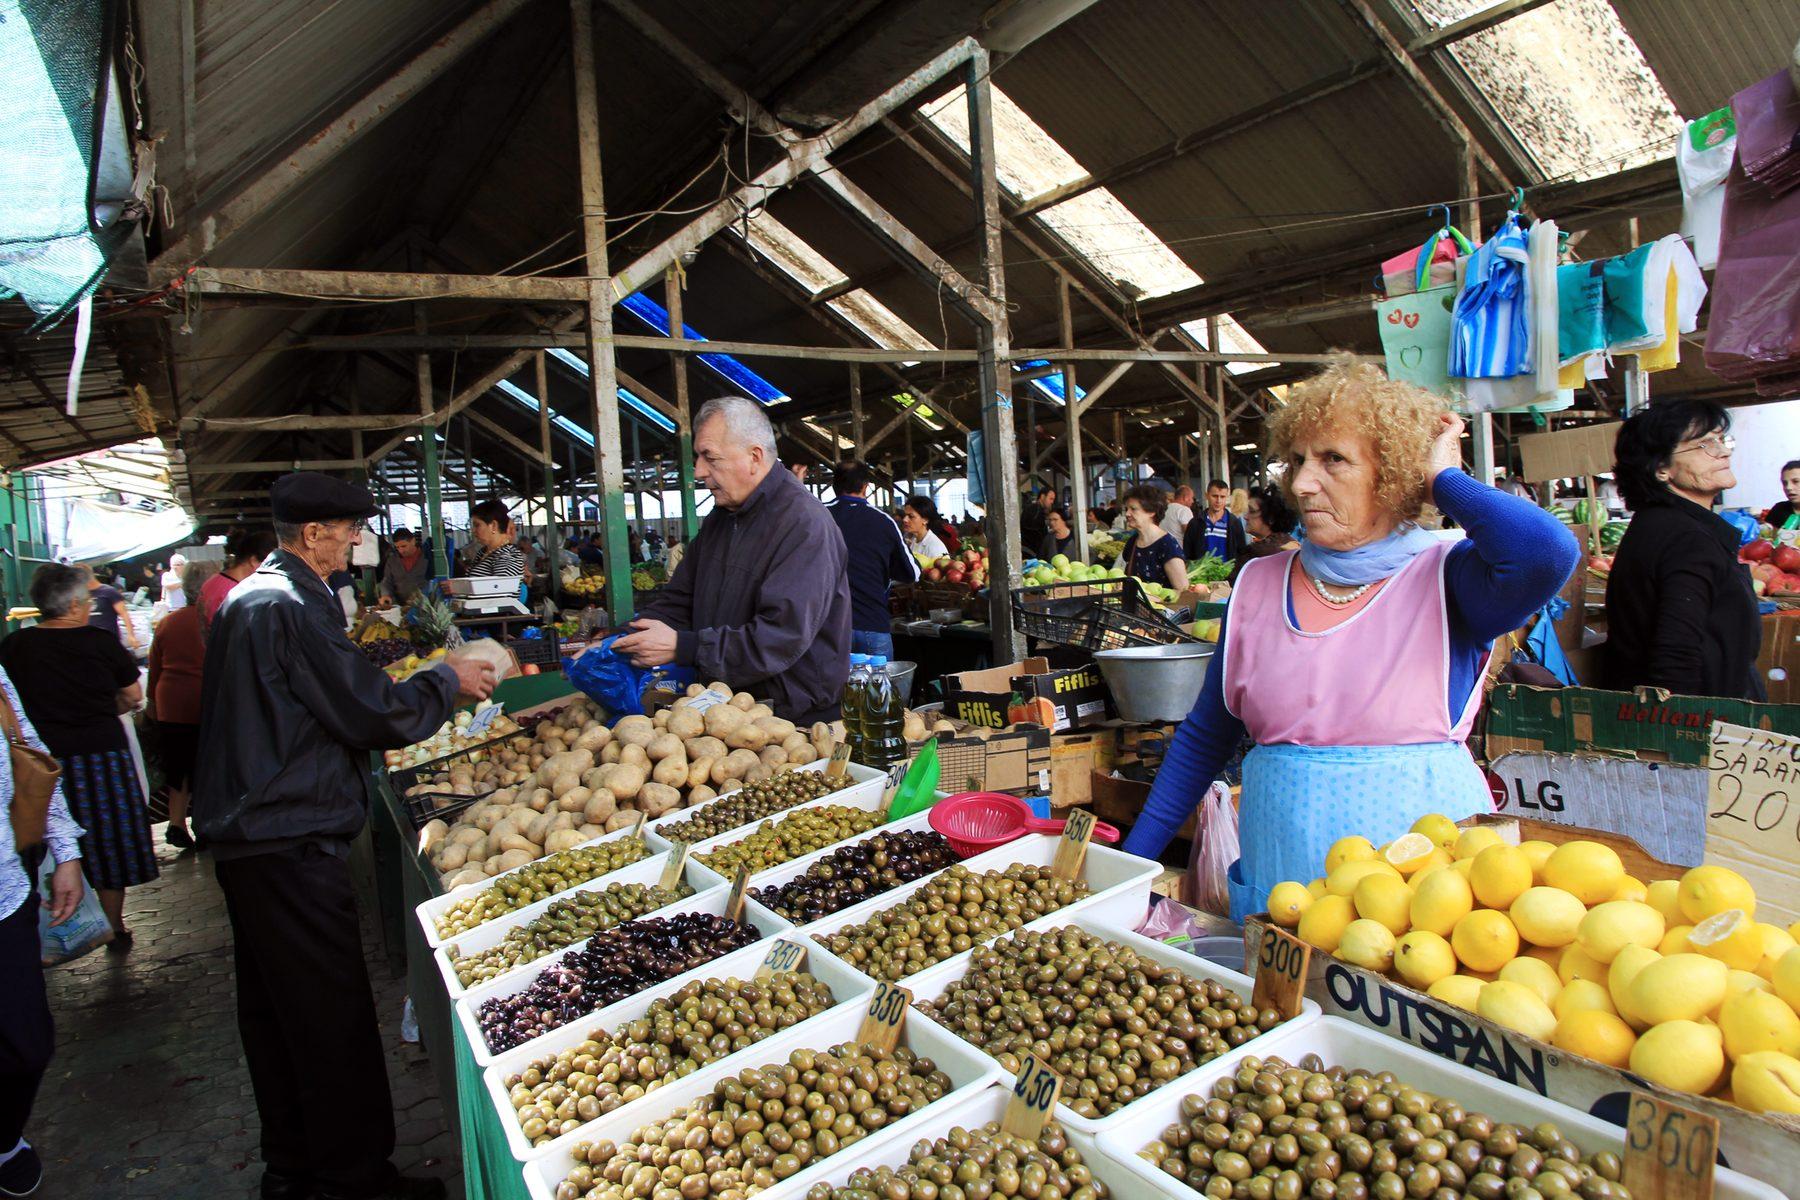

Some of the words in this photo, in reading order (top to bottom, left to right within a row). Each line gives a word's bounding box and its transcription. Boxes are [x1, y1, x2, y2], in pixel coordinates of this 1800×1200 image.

[1054, 671, 1100, 694] Fiflis
[958, 701, 1003, 728] Fiflis
[1515, 777, 1565, 812] LG
[1710, 773, 1800, 842] 20
[1065, 810, 1092, 842] 350
[765, 939, 801, 970] 350
[1262, 929, 1302, 980] 300
[869, 982, 906, 1027] 350
[1325, 963, 1549, 1098] OUTSPAN
[1014, 1055, 1056, 1111] 250
